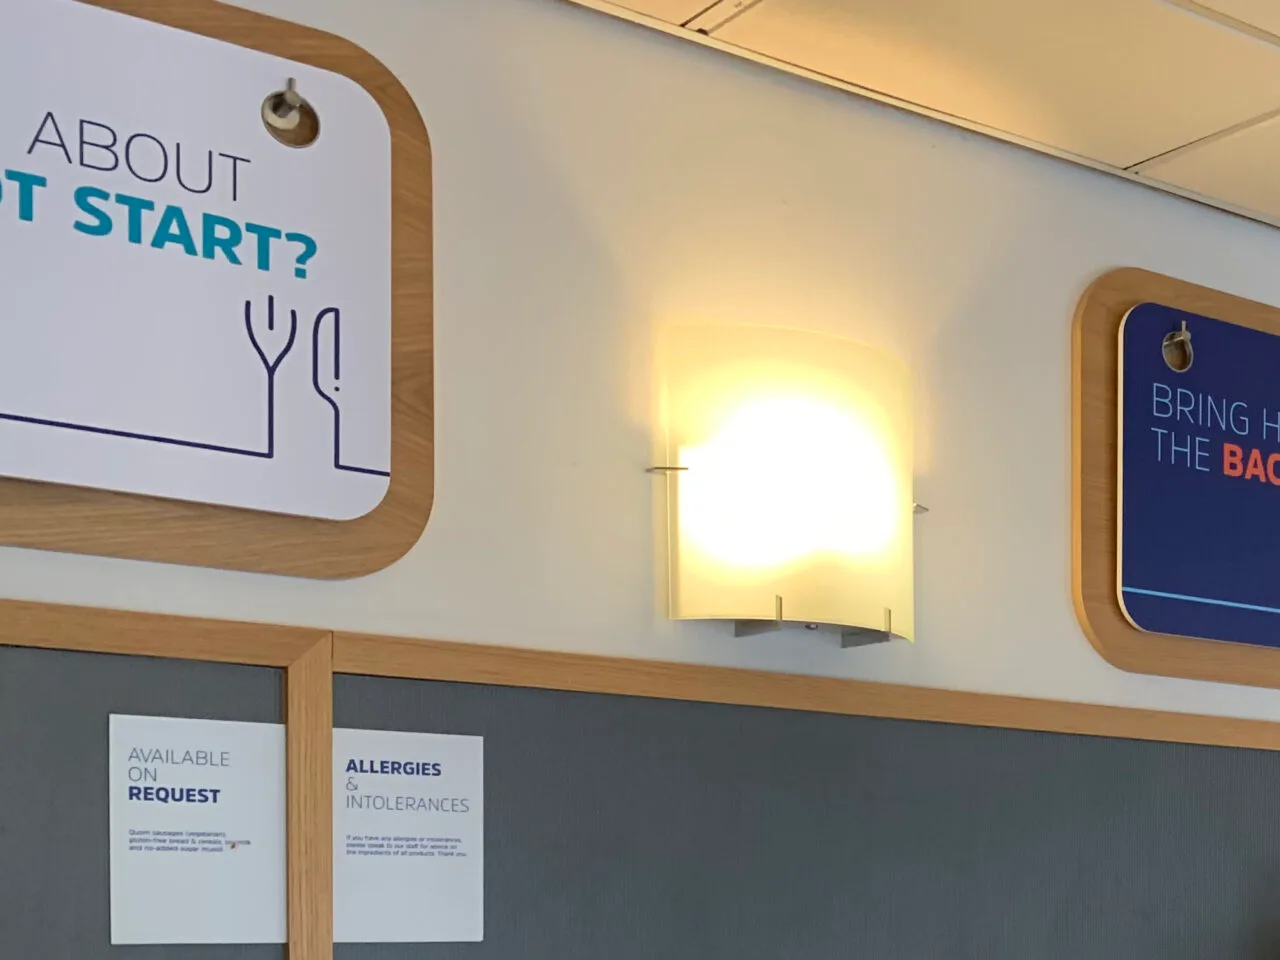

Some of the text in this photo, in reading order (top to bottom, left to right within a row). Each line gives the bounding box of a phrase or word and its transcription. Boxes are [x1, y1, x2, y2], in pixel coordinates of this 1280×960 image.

[27, 111, 251, 202] ABOUT
[0, 168, 317, 279] T START?
[1152, 382, 1249, 435] BRING
[1151, 427, 1210, 472] THE
[128, 747, 230, 767] AVAILABLE
[128, 766, 157, 783] ON
[345, 758, 441, 777] ALLERGIES
[346, 776, 358, 791] &
[128, 786, 221, 804] REQUEST
[346, 795, 470, 813] INTOLERANCES
